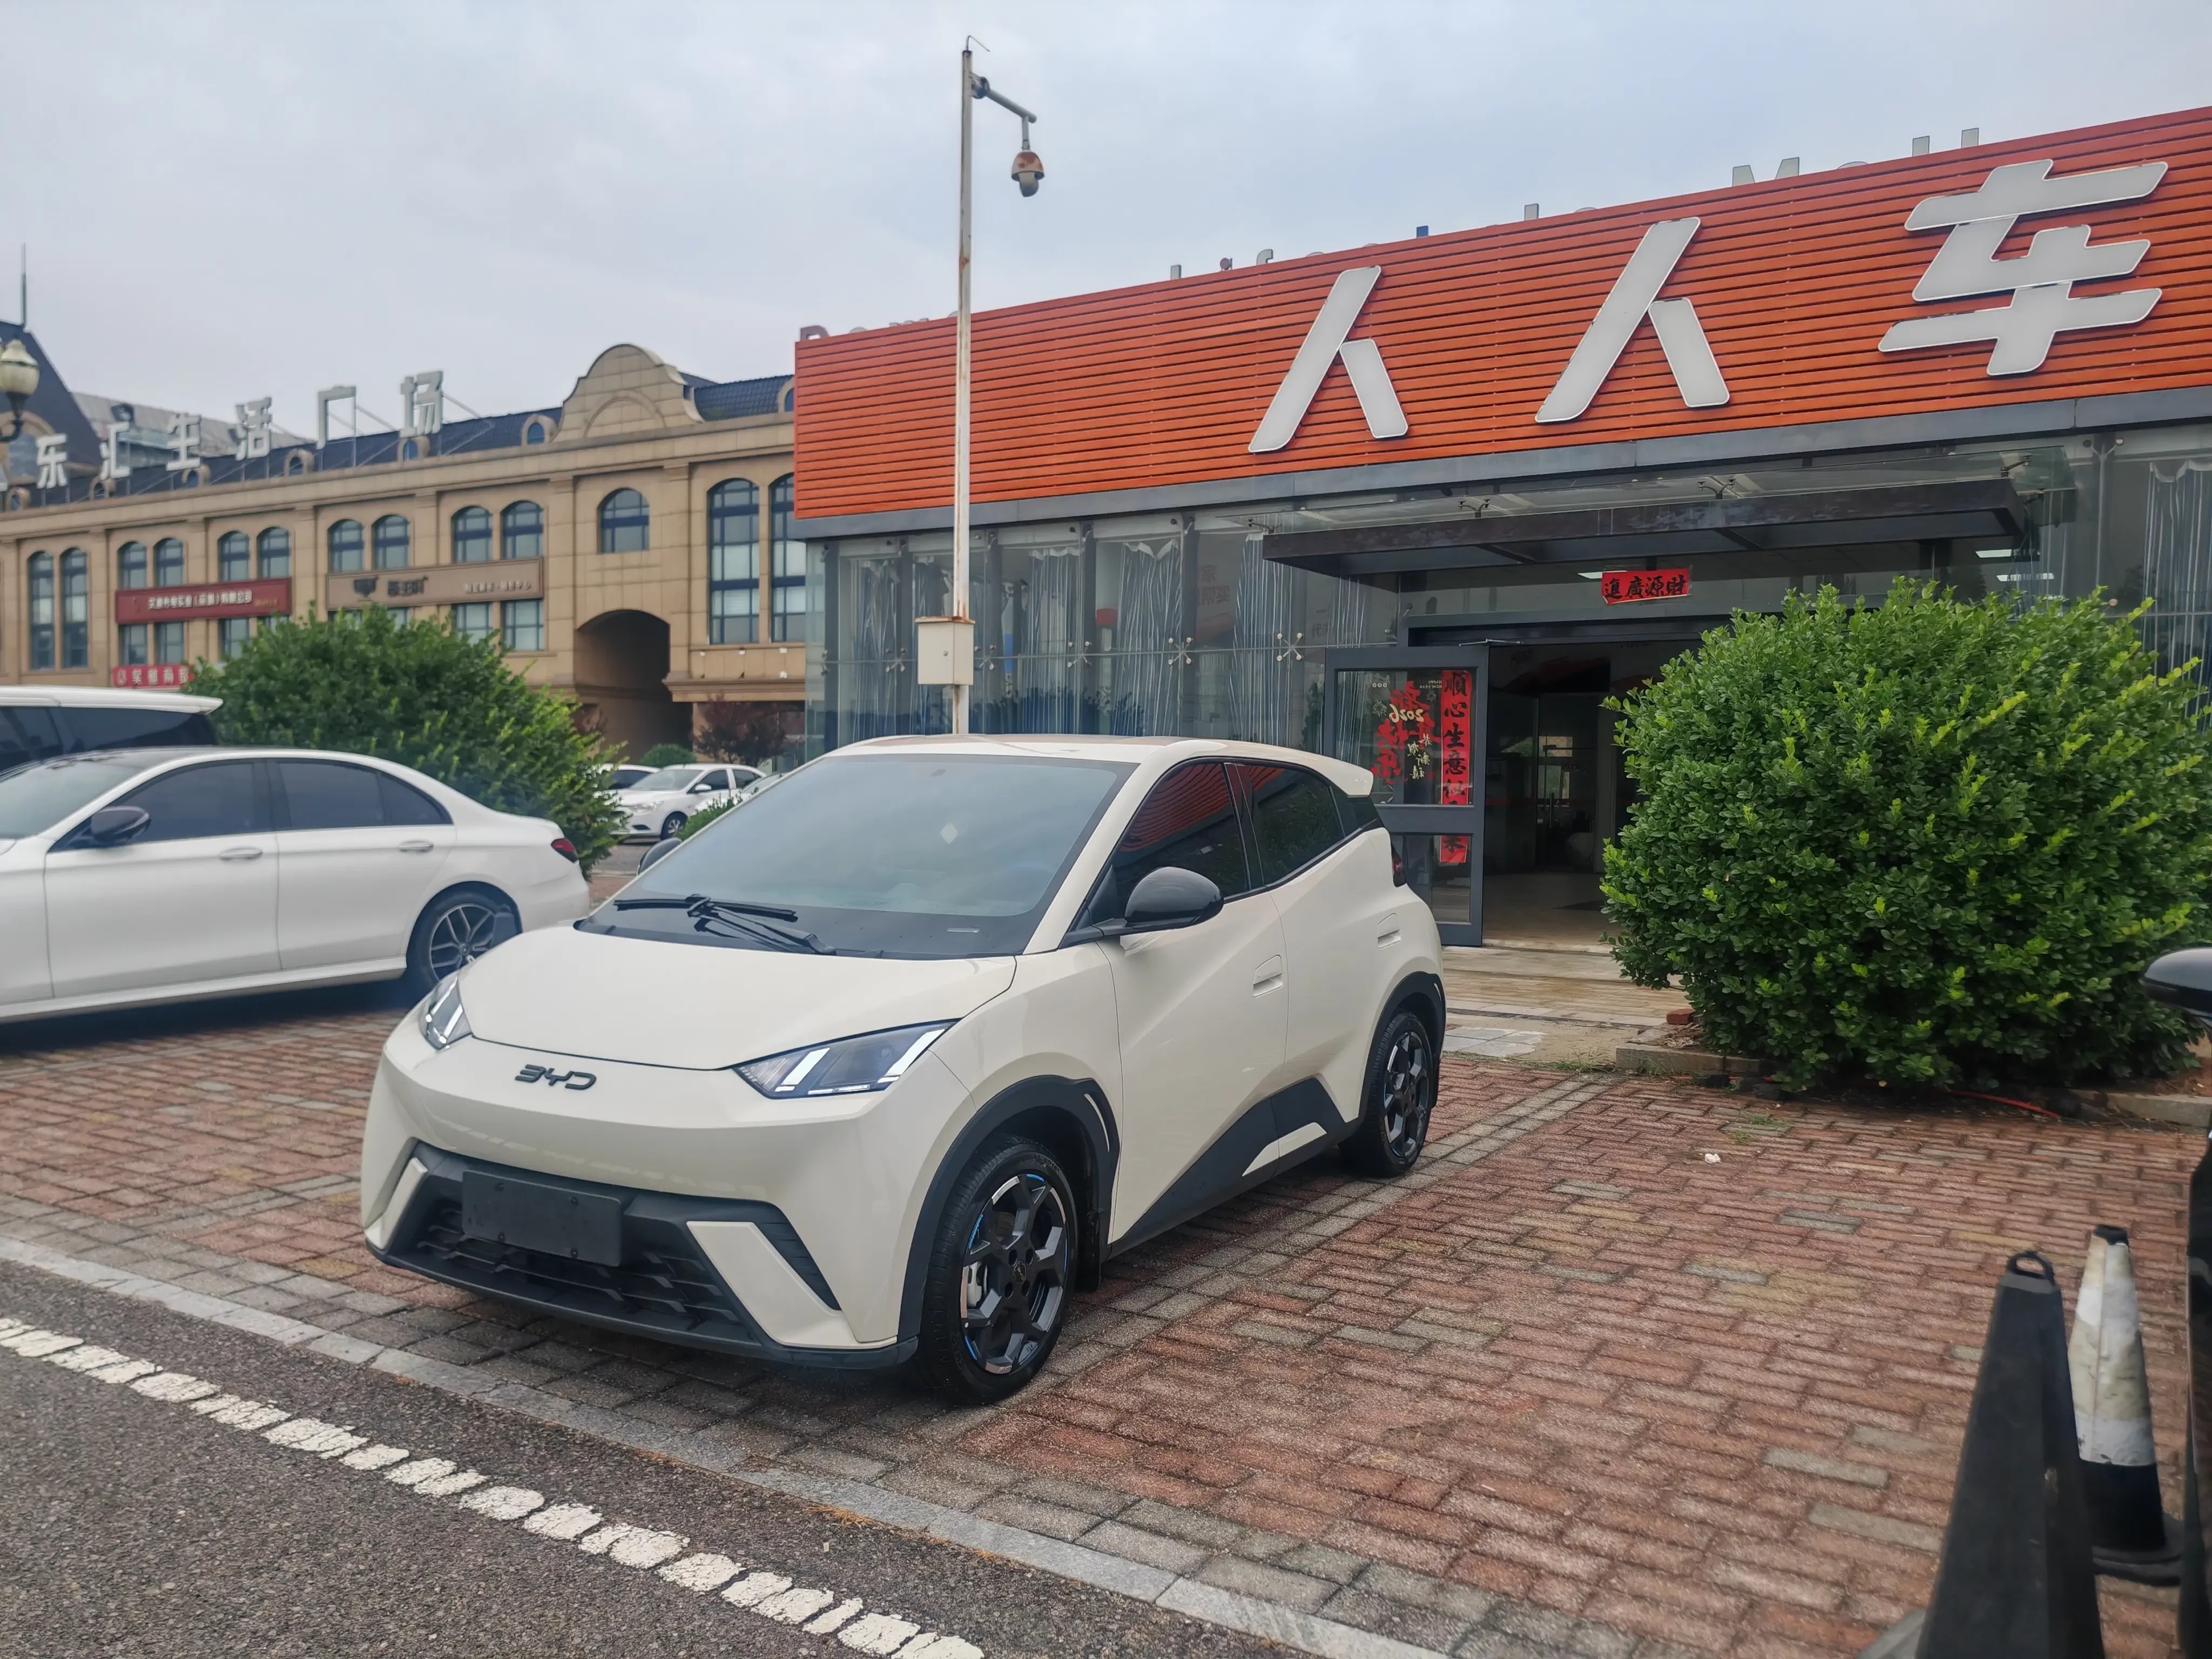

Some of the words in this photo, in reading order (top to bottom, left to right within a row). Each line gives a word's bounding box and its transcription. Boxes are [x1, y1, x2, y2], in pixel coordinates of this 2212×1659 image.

[1248, 159, 2168, 453] 人人车
[0, 370, 443, 492] 乐汇生活广场
[515, 1063, 597, 1090] BYD
